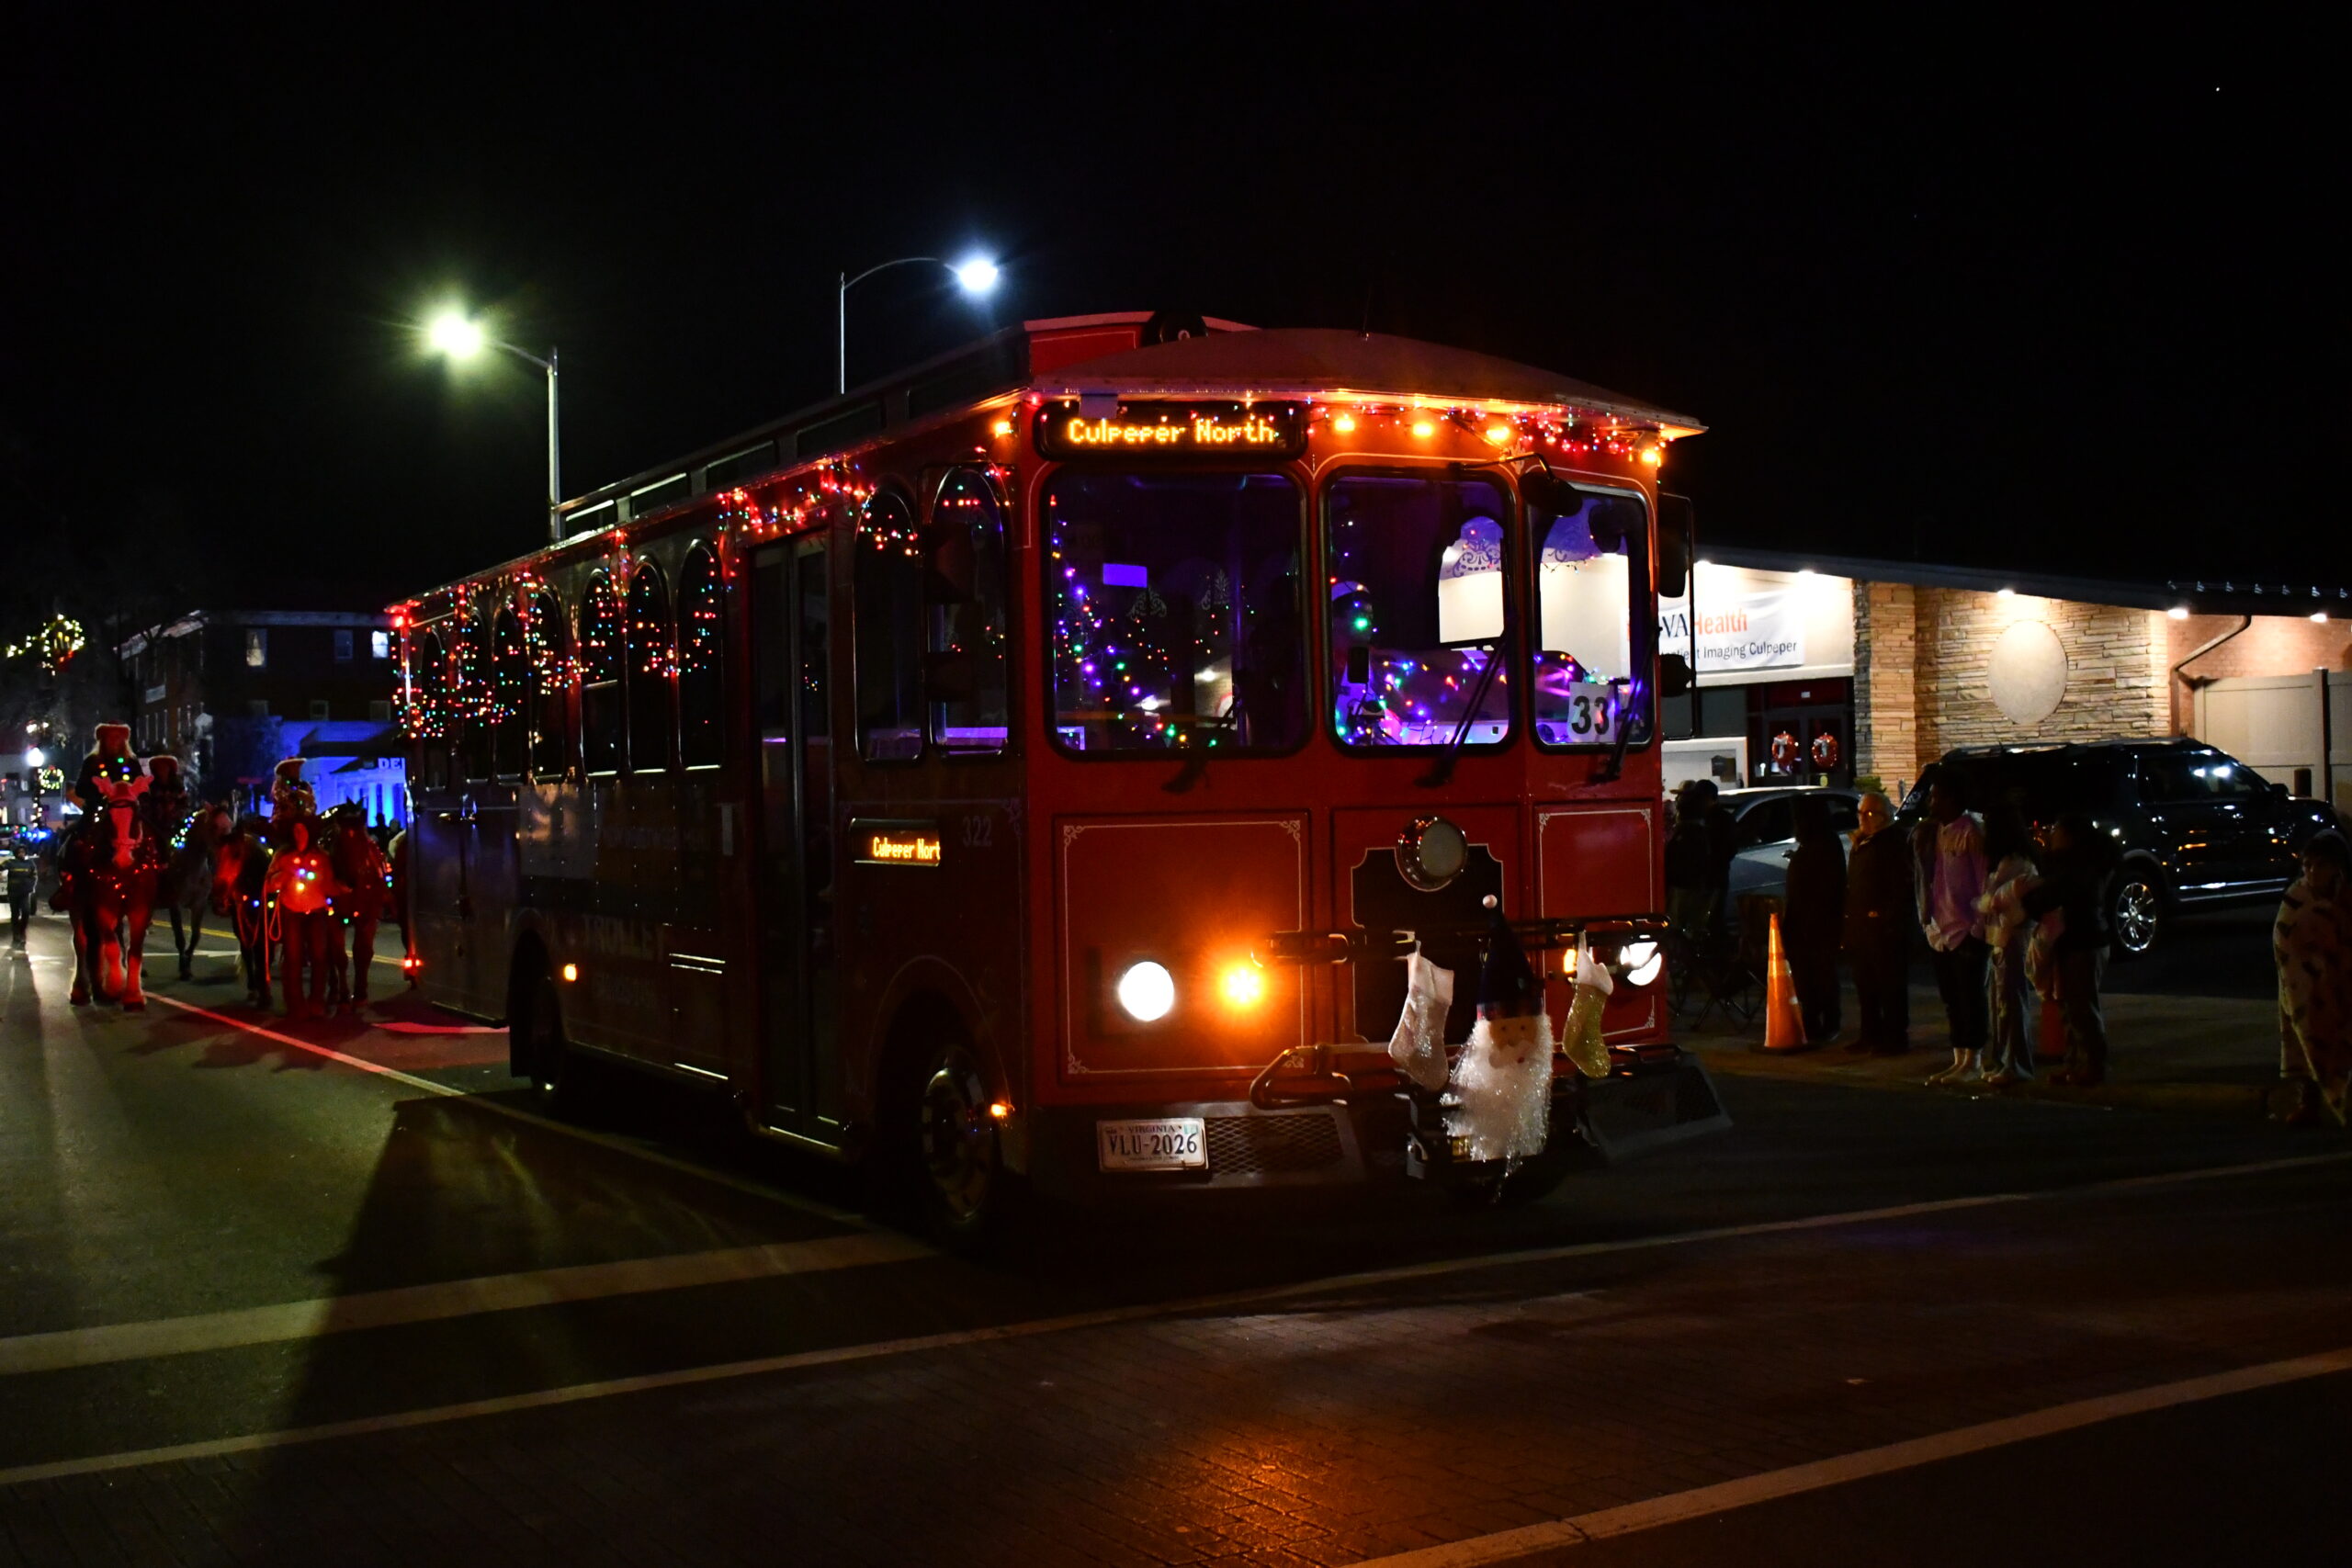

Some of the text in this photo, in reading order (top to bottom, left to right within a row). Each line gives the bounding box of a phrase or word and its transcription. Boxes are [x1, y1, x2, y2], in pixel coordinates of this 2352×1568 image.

[1069, 418, 1274, 443] Culpeper North
[1694, 608, 1747, 635] Health
[1703, 646, 1746, 660] Imaging
[1749, 640, 1797, 657] Culpeper
[1571, 695, 1609, 735] 33
[962, 816, 992, 848] 322
[873, 836, 915, 859] Culpeper
[1128, 1125, 1176, 1134] VIRGINIA
[1109, 1133, 1197, 1156] VLU-2026
